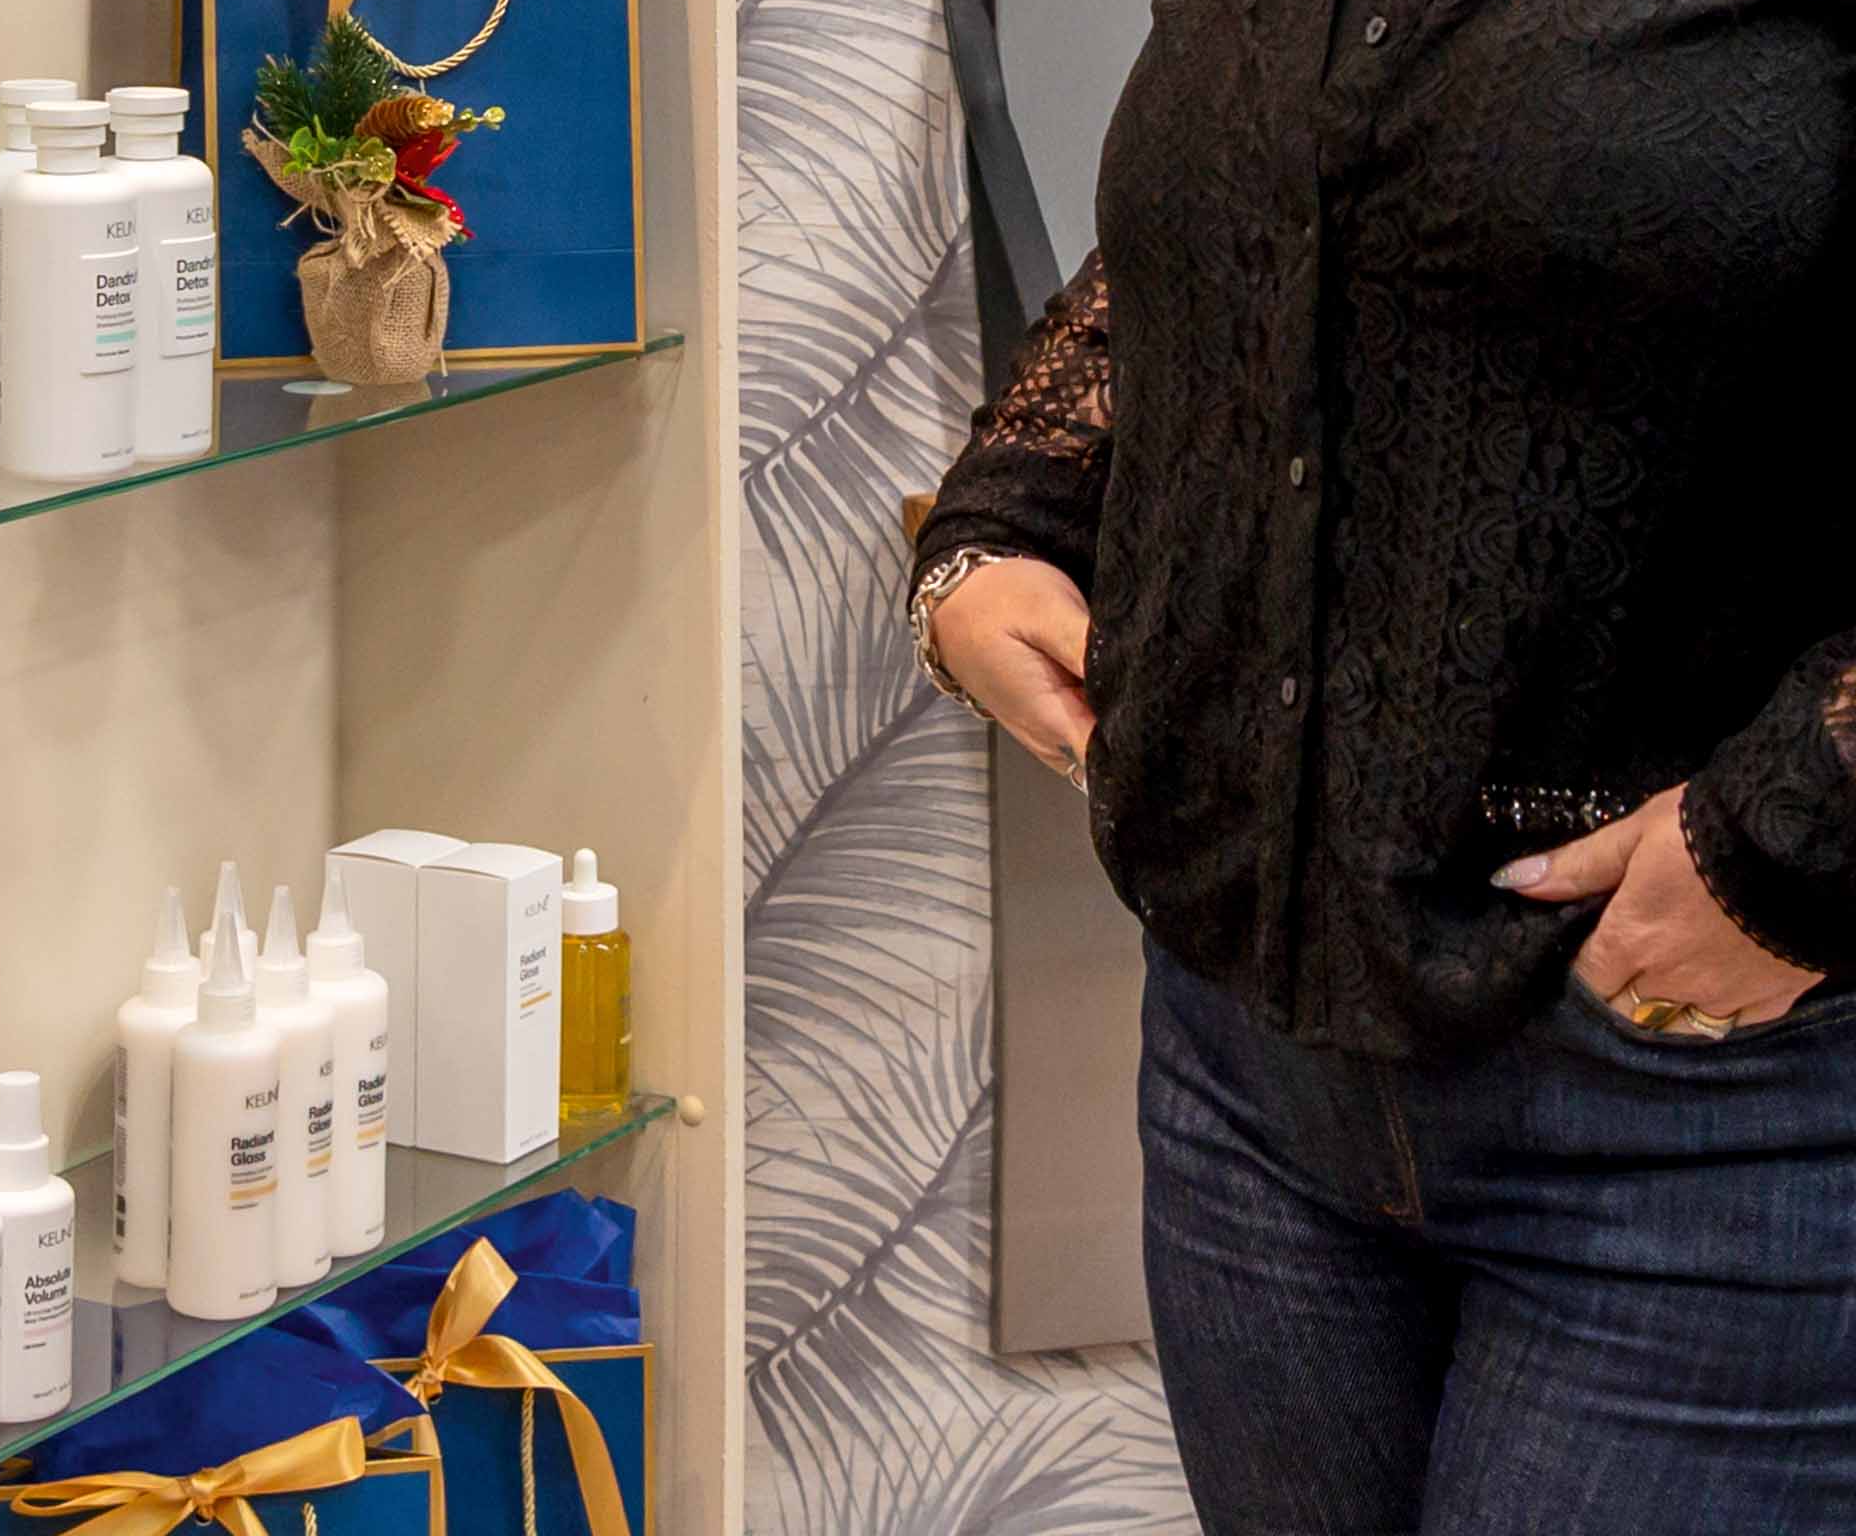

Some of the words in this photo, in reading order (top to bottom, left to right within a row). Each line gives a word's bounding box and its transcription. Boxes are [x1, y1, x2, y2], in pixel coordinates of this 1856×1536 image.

[176, 276, 209, 292] Detox
[96, 291, 131, 308] Detox
[231, 1150, 266, 1167] Gloss
[25, 1285, 68, 1306] Volume
